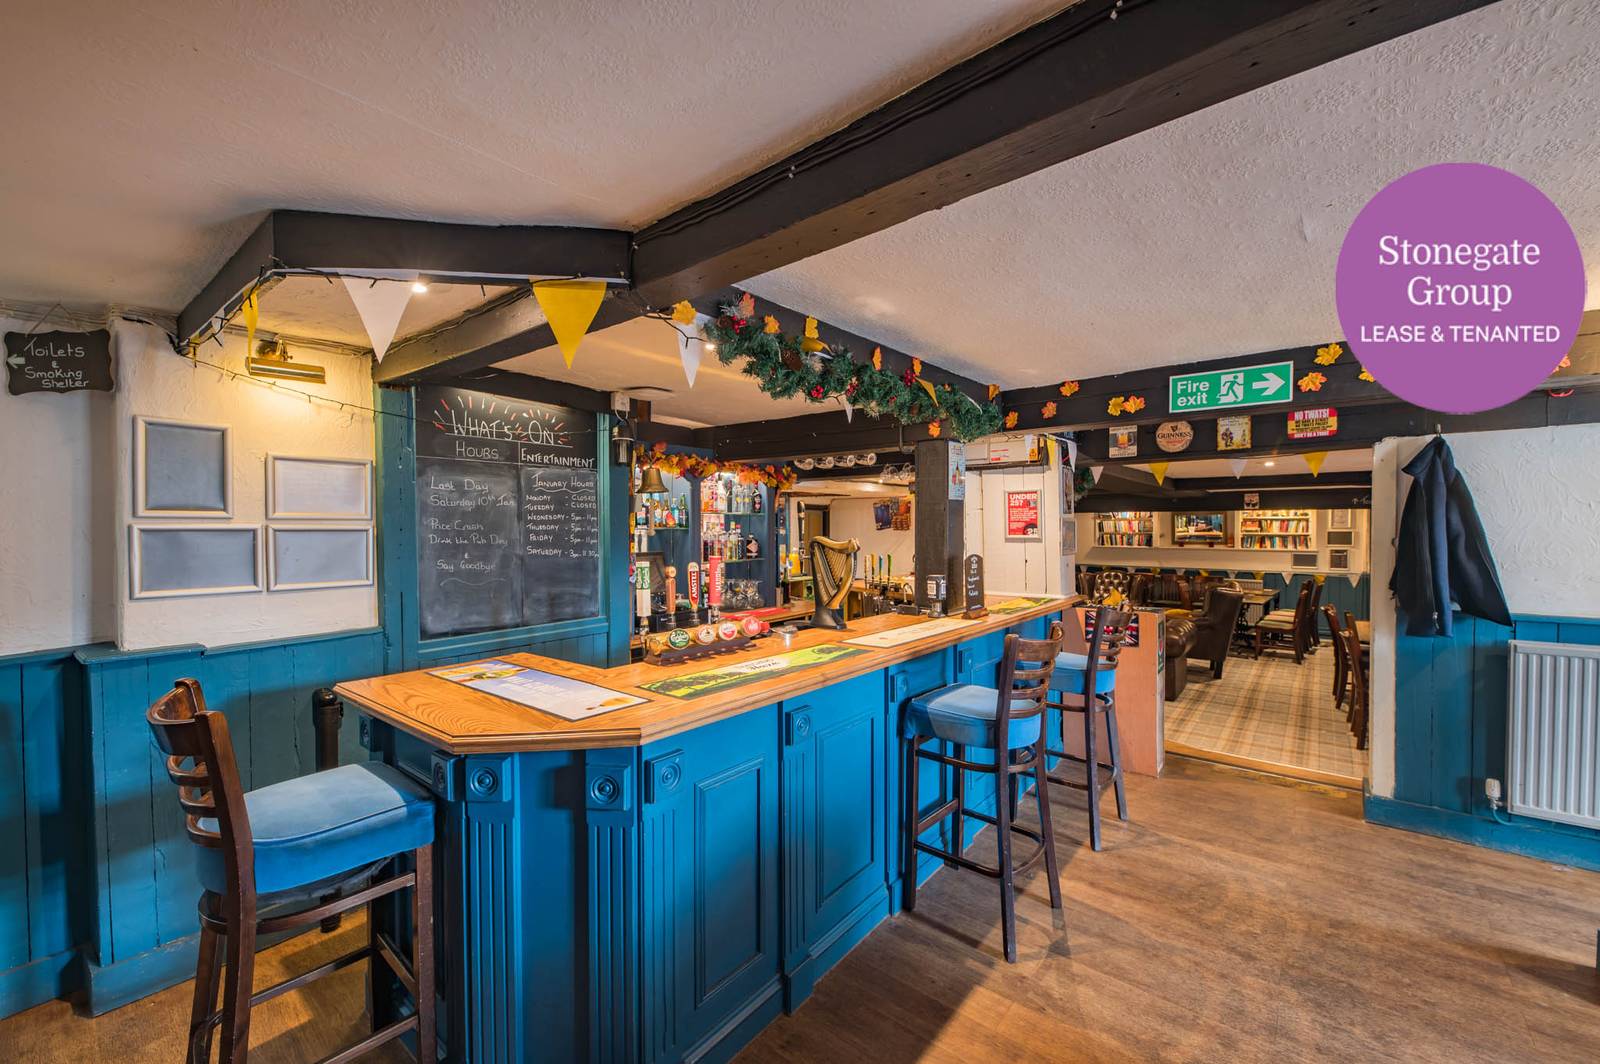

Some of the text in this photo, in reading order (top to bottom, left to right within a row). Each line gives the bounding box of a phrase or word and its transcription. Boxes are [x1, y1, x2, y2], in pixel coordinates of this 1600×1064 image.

[41, 379, 89, 388] Shelter
[1177, 380, 1210, 394] Fire
[1177, 392, 1208, 407] exit
[452, 409, 554, 445] WHAT'S ON
[1157, 431, 1192, 440] GUINNESS
[456, 440, 499, 460] HOURS
[521, 448, 594, 468] ENTERTAINMENT
[431, 475, 489, 494] Last Day
[430, 494, 475, 511] Saturday
[496, 492, 515, 507] Jan
[571, 494, 596, 502] CLOSED
[524, 503, 555, 511] TUESDAY
[431, 517, 451, 530] Price
[527, 513, 565, 521] WEDNESDAY
[526, 522, 560, 532] THURSDAY
[455, 536, 469, 544] the
[470, 533, 487, 544] Pub
[526, 545, 562, 557] SATURDAY
[437, 559, 454, 572] Say
